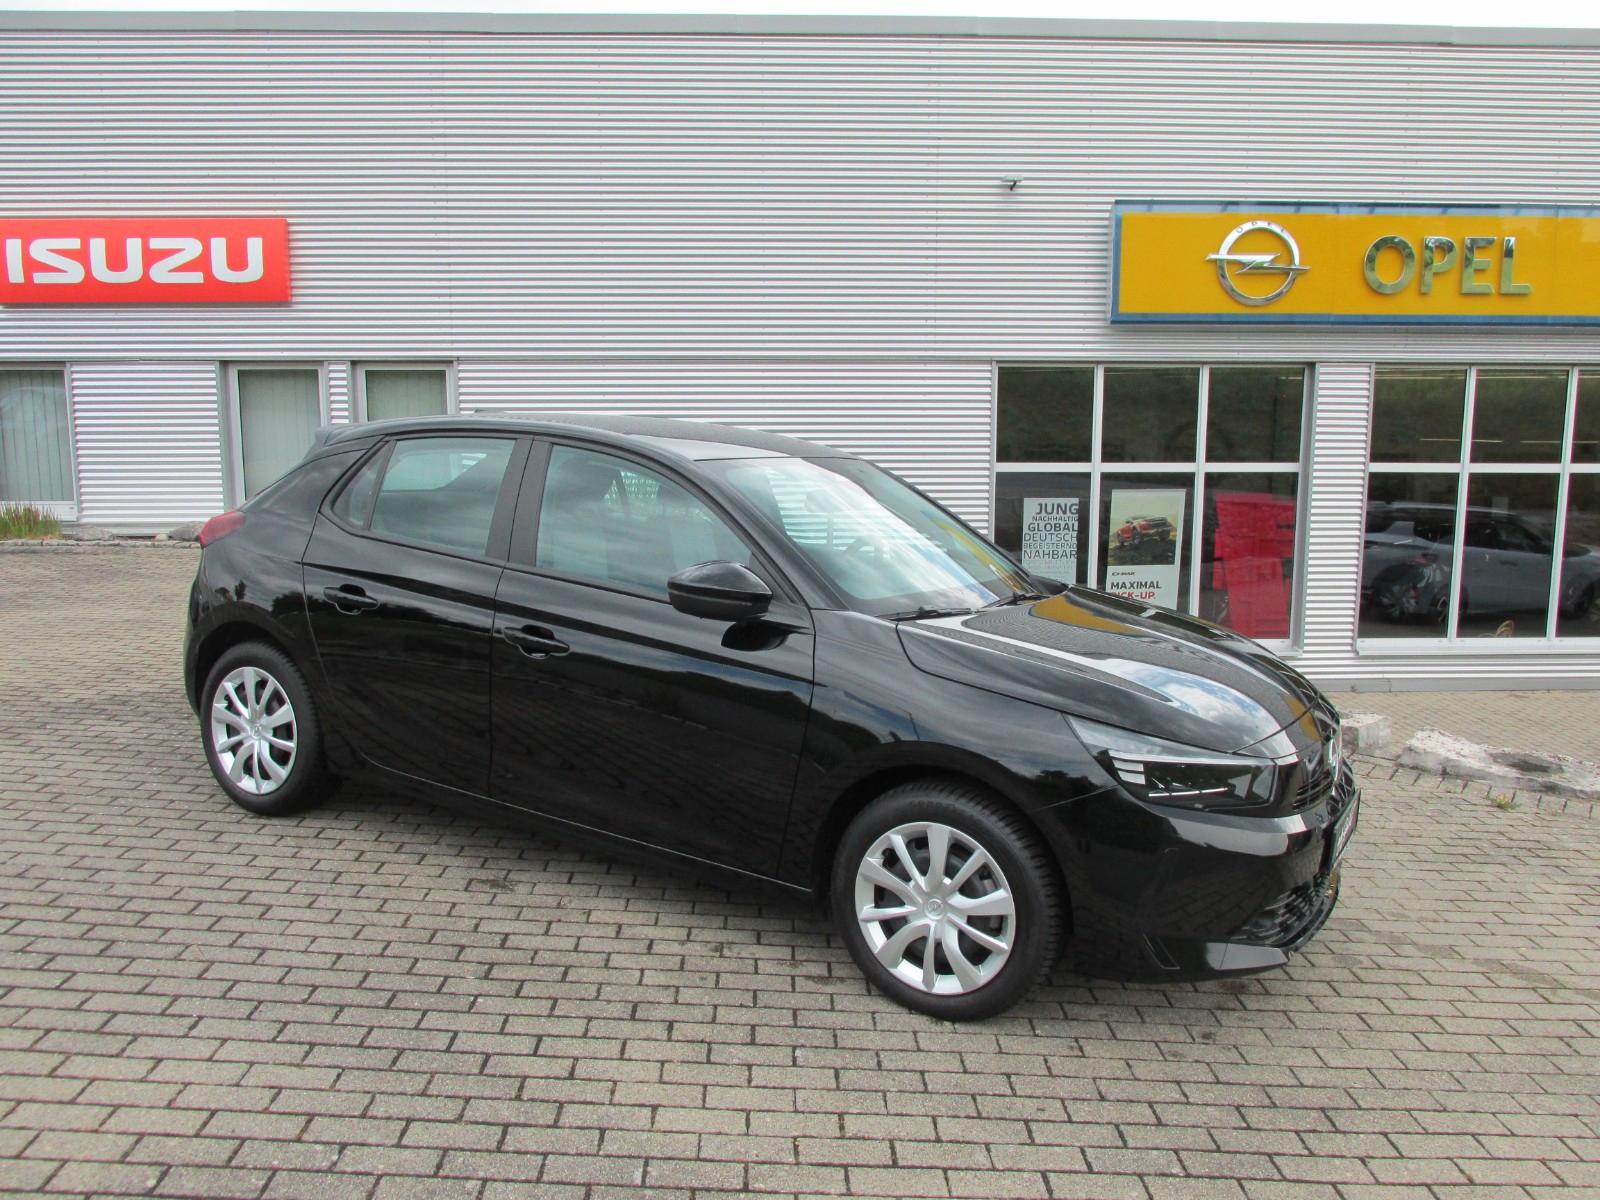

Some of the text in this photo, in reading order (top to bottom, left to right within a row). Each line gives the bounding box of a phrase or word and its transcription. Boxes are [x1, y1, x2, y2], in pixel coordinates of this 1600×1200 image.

[5, 237, 264, 284] ISUZU
[1364, 234, 1533, 295] OPEL
[1035, 502, 1079, 515] JUNG
[1027, 522, 1078, 532] GLOBAL
[1023, 532, 1077, 542] DEUTSCH
[1023, 549, 1078, 559] NAHBAR
[1110, 580, 1162, 590] MAXIMAL
